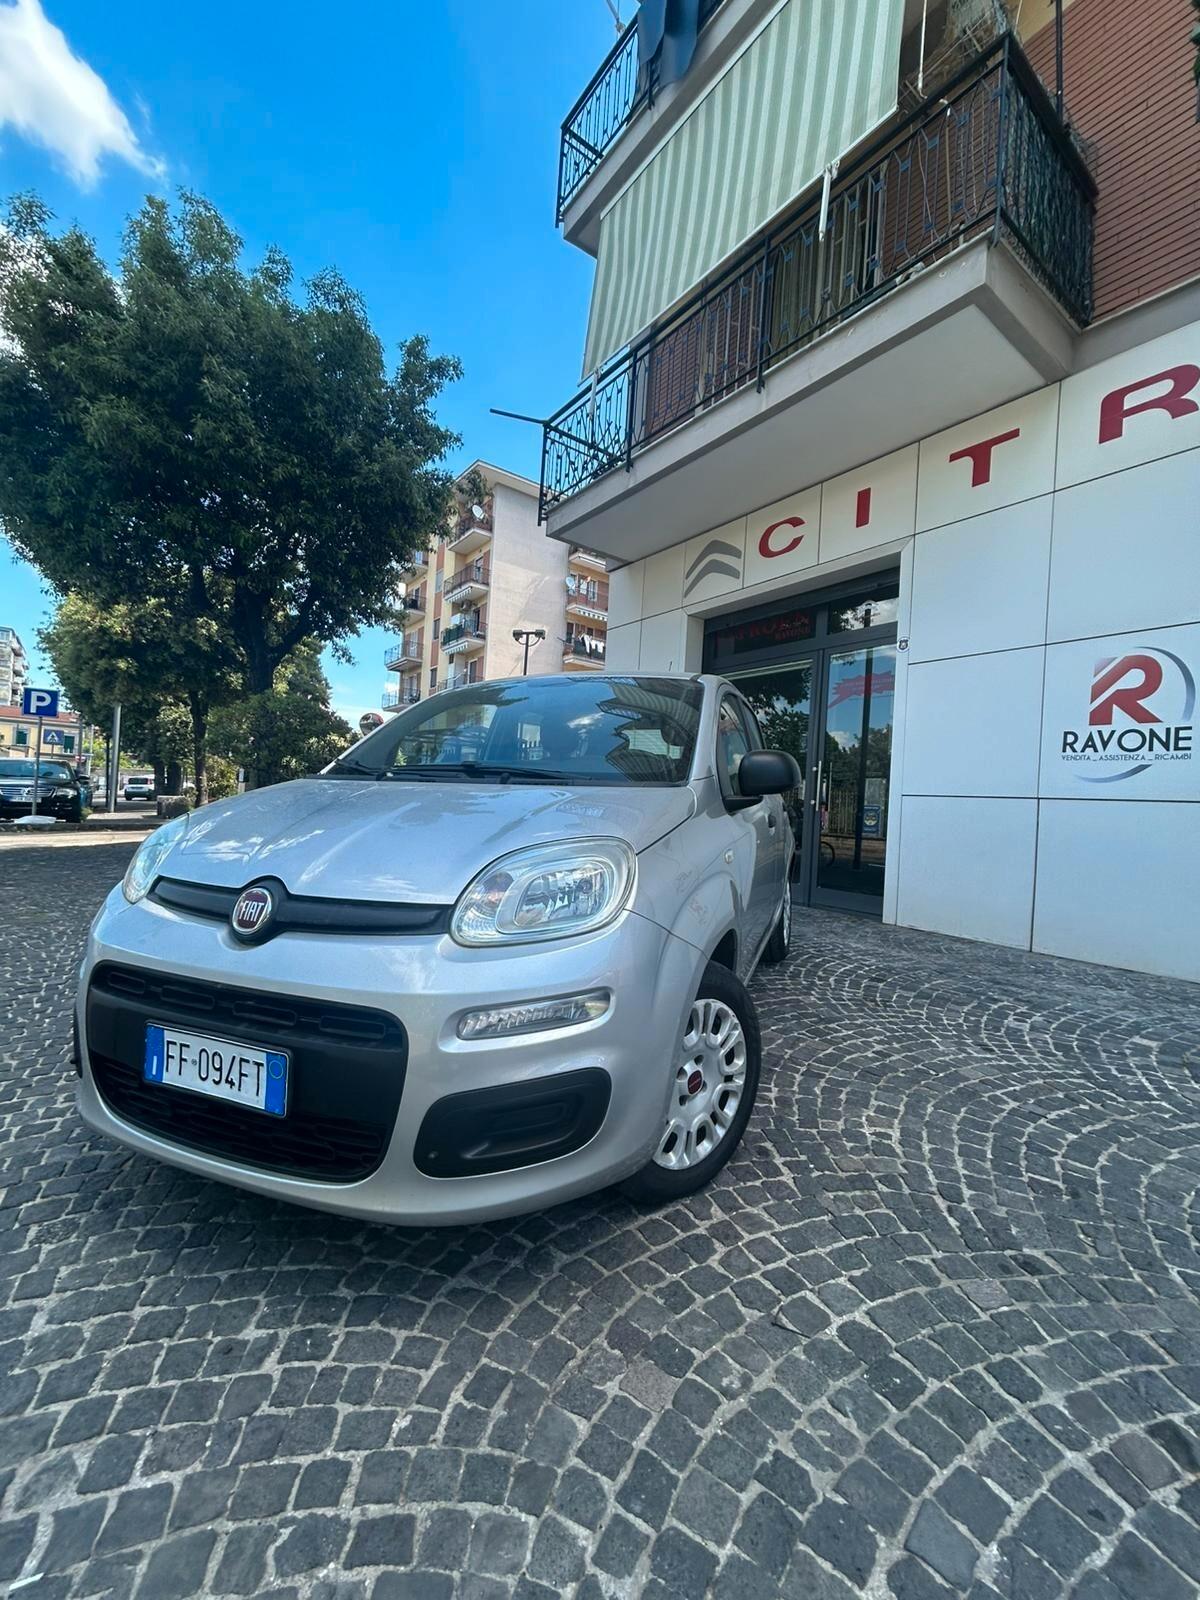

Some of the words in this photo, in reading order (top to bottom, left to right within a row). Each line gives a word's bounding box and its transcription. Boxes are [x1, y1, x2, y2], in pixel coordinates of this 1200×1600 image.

[30, 691, 52, 713] P
[1062, 726, 1193, 753] RAVONE
[1154, 752, 1192, 760] RICAMBI
[239, 900, 265, 922] FIAT
